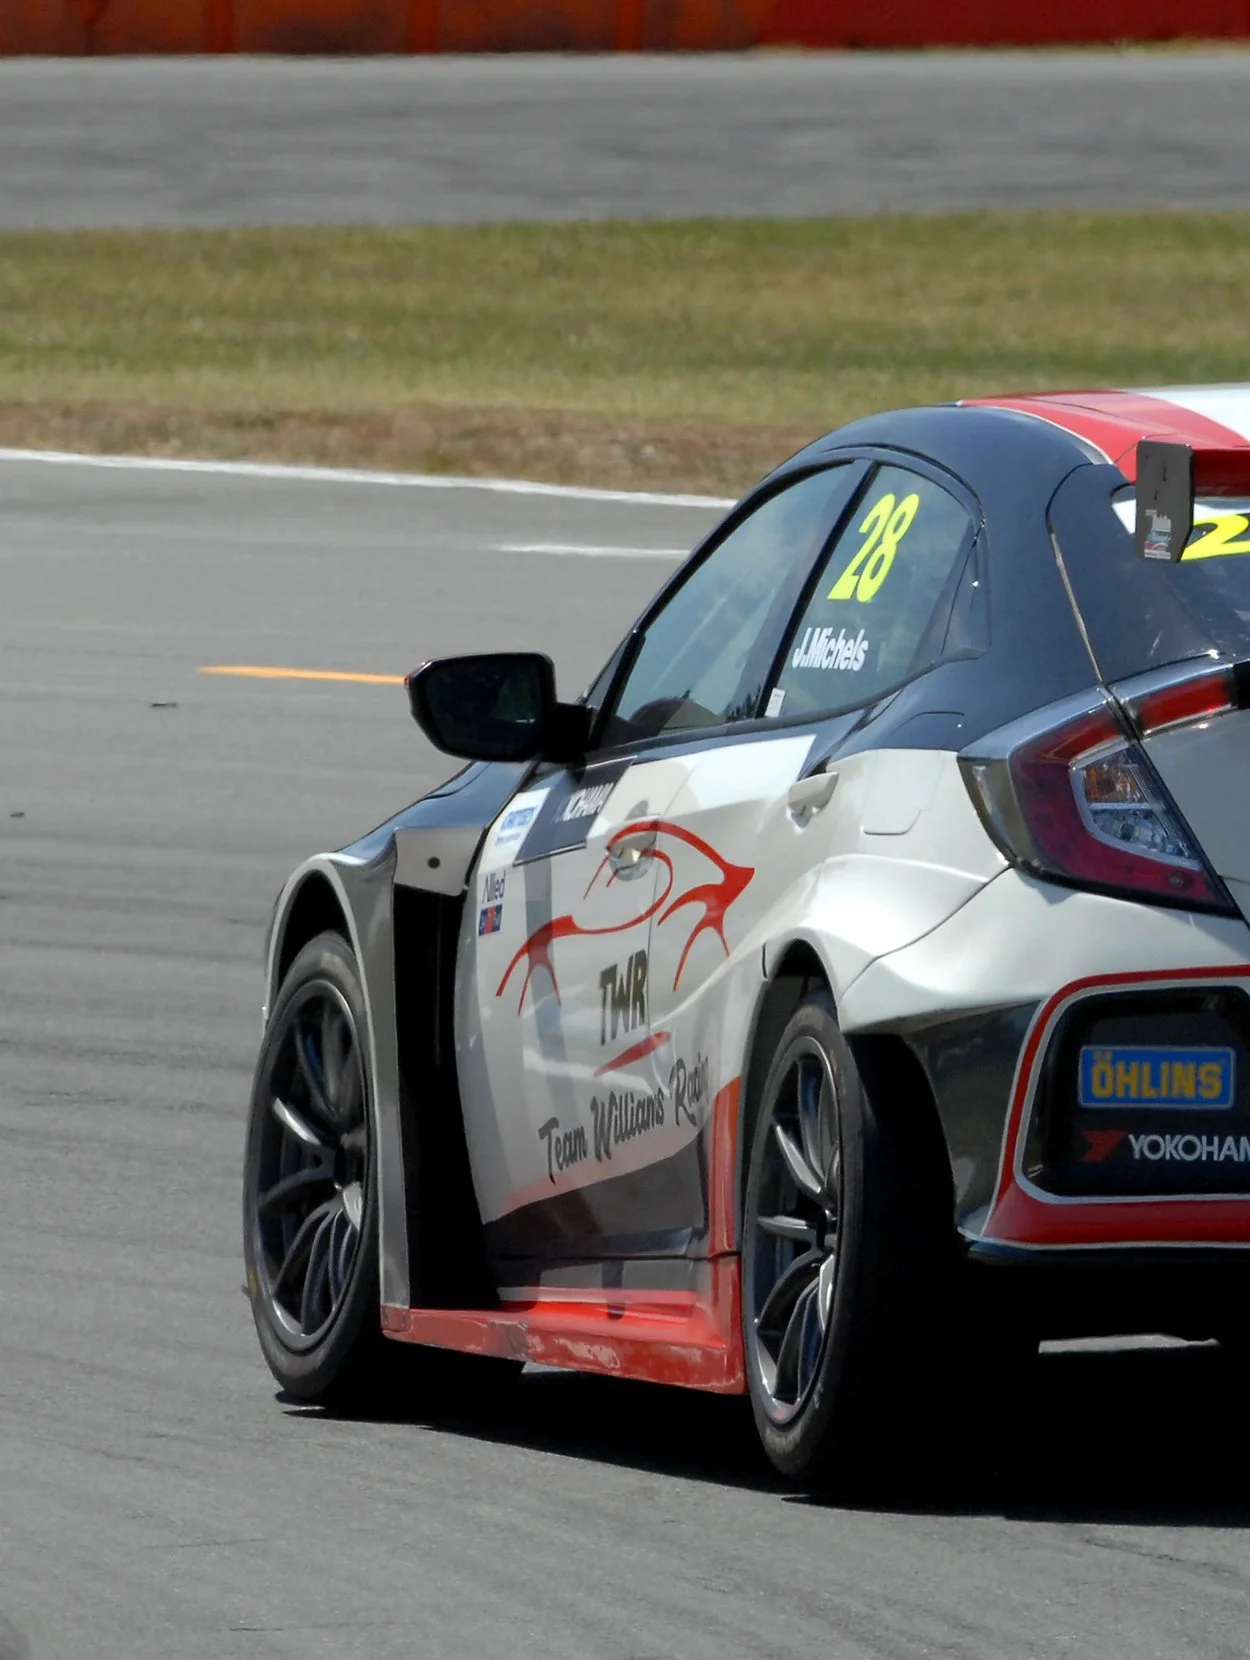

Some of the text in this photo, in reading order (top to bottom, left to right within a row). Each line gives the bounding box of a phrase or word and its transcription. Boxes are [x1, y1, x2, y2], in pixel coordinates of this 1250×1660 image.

[827, 493, 920, 603] 28
[791, 627, 869, 672] J.Michels
[600, 949, 648, 1047] TWR
[1091, 1051, 1224, 1100] ÖHLINS
[538, 1116, 588, 1185] Team
[590, 1089, 665, 1164] Williams
